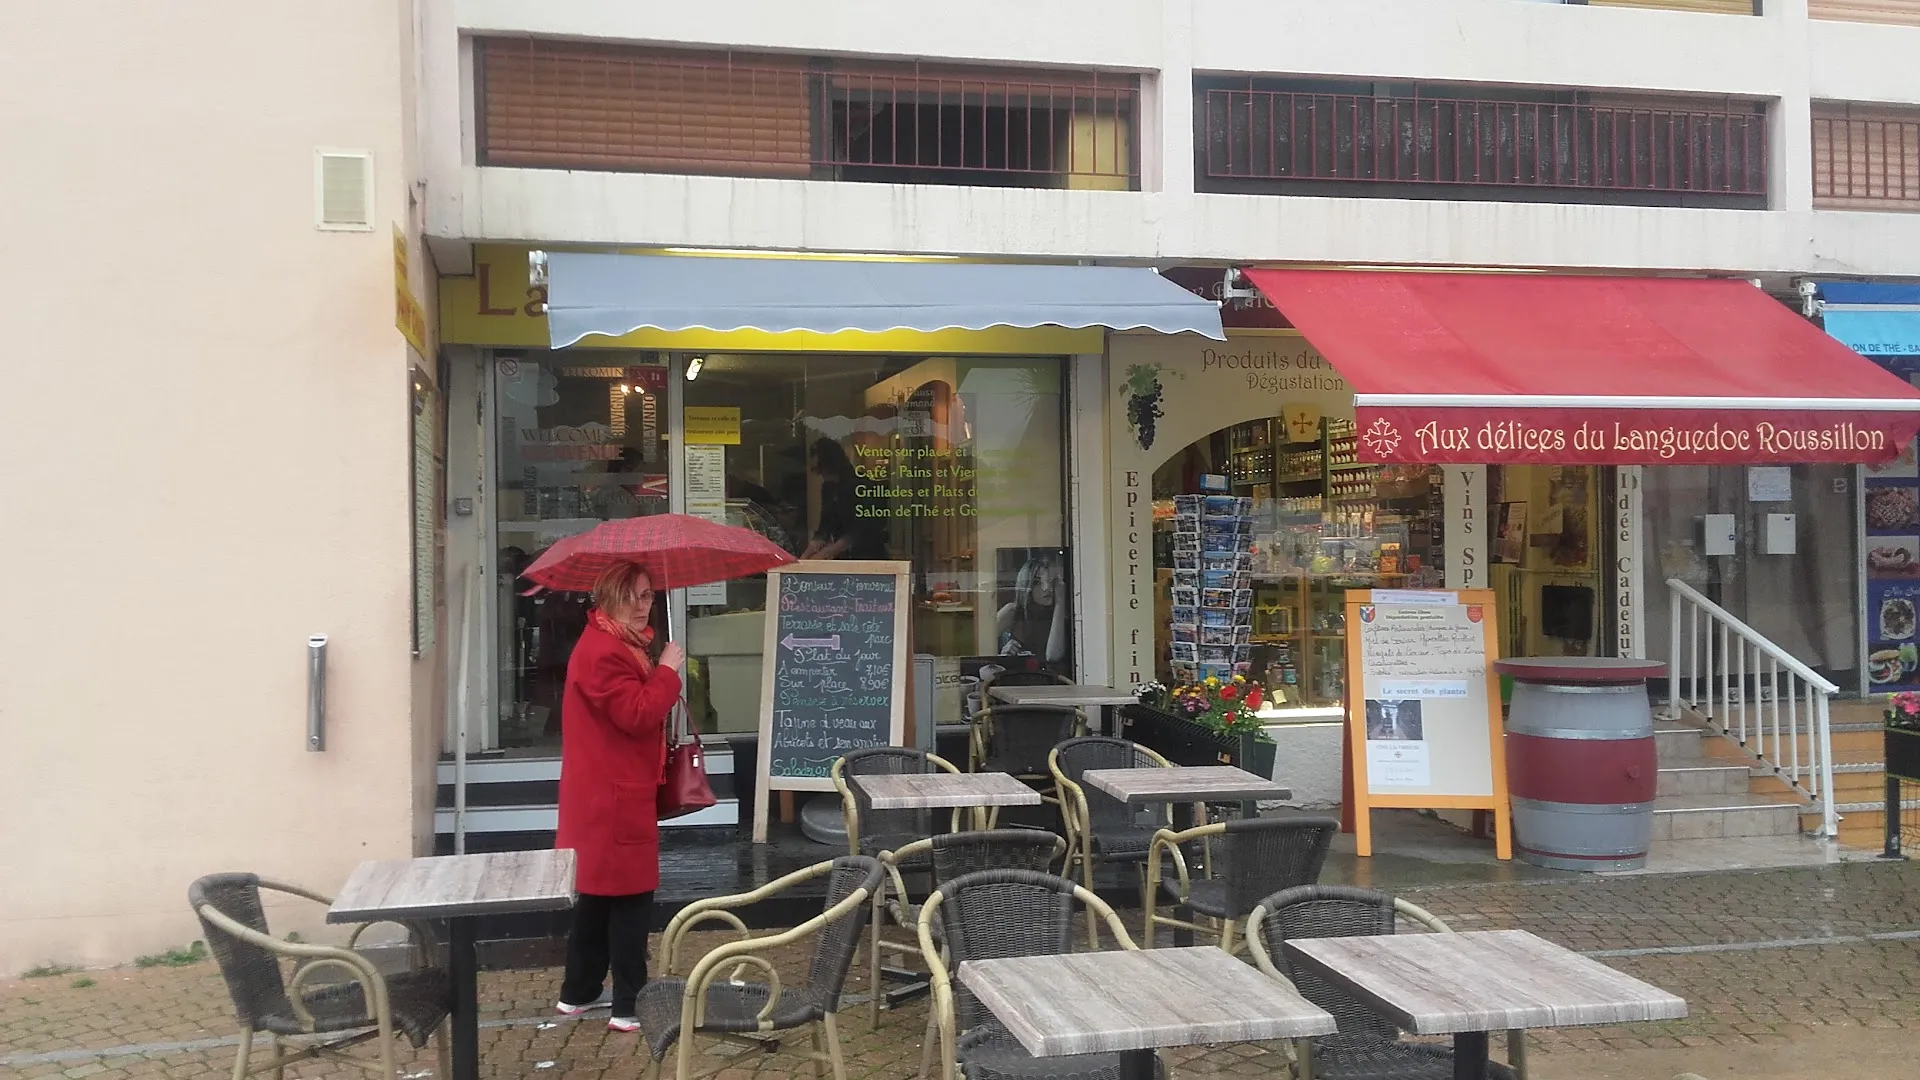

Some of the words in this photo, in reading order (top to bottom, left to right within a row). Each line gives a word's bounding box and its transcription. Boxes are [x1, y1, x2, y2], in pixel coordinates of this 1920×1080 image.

[477, 264, 548, 317] La
[1851, 344, 1866, 352] ON
[1869, 344, 1881, 352] DE
[1201, 349, 1289, 372] Produits
[1296, 350, 1321, 369] du
[1246, 373, 1343, 394] Dégustation
[1415, 420, 1471, 455] Aux
[1477, 421, 1566, 454] délices
[1574, 421, 1604, 450] du
[1613, 421, 1750, 458] Languedoc
[1756, 421, 1884, 454] Roussillon
[855, 444, 891, 457] Vente
[895, 447, 914, 457] sur
[918, 445, 951, 462] place
[955, 447, 967, 457] et
[855, 465, 887, 478] Café
[899, 465, 932, 478] Pains
[936, 467, 949, 478] et
[855, 484, 914, 498] Grillades
[917, 487, 929, 498] et
[934, 485, 963, 498] Plats
[855, 505, 891, 518] Salon
[943, 507, 955, 518] et
[1460, 471, 1474, 534] Vins
[1618, 473, 1629, 542] Idée
[1126, 471, 1139, 610] Epicerie
[1462, 547, 1474, 588] Sp
[780, 614, 823, 631] Terrasse
[826, 617, 836, 632] et
[865, 633, 893, 649] parc
[794, 648, 832, 664] Plat
[835, 648, 852, 661] du
[854, 649, 881, 672] jour
[791, 665, 838, 683] emporter
[779, 675, 805, 689] Sur
[813, 678, 848, 693] place
[1382, 687, 1392, 695] Le
[1396, 687, 1419, 695] secret
[1422, 687, 1435, 695] des
[1439, 687, 1467, 696] plantes
[818, 731, 832, 749] et
